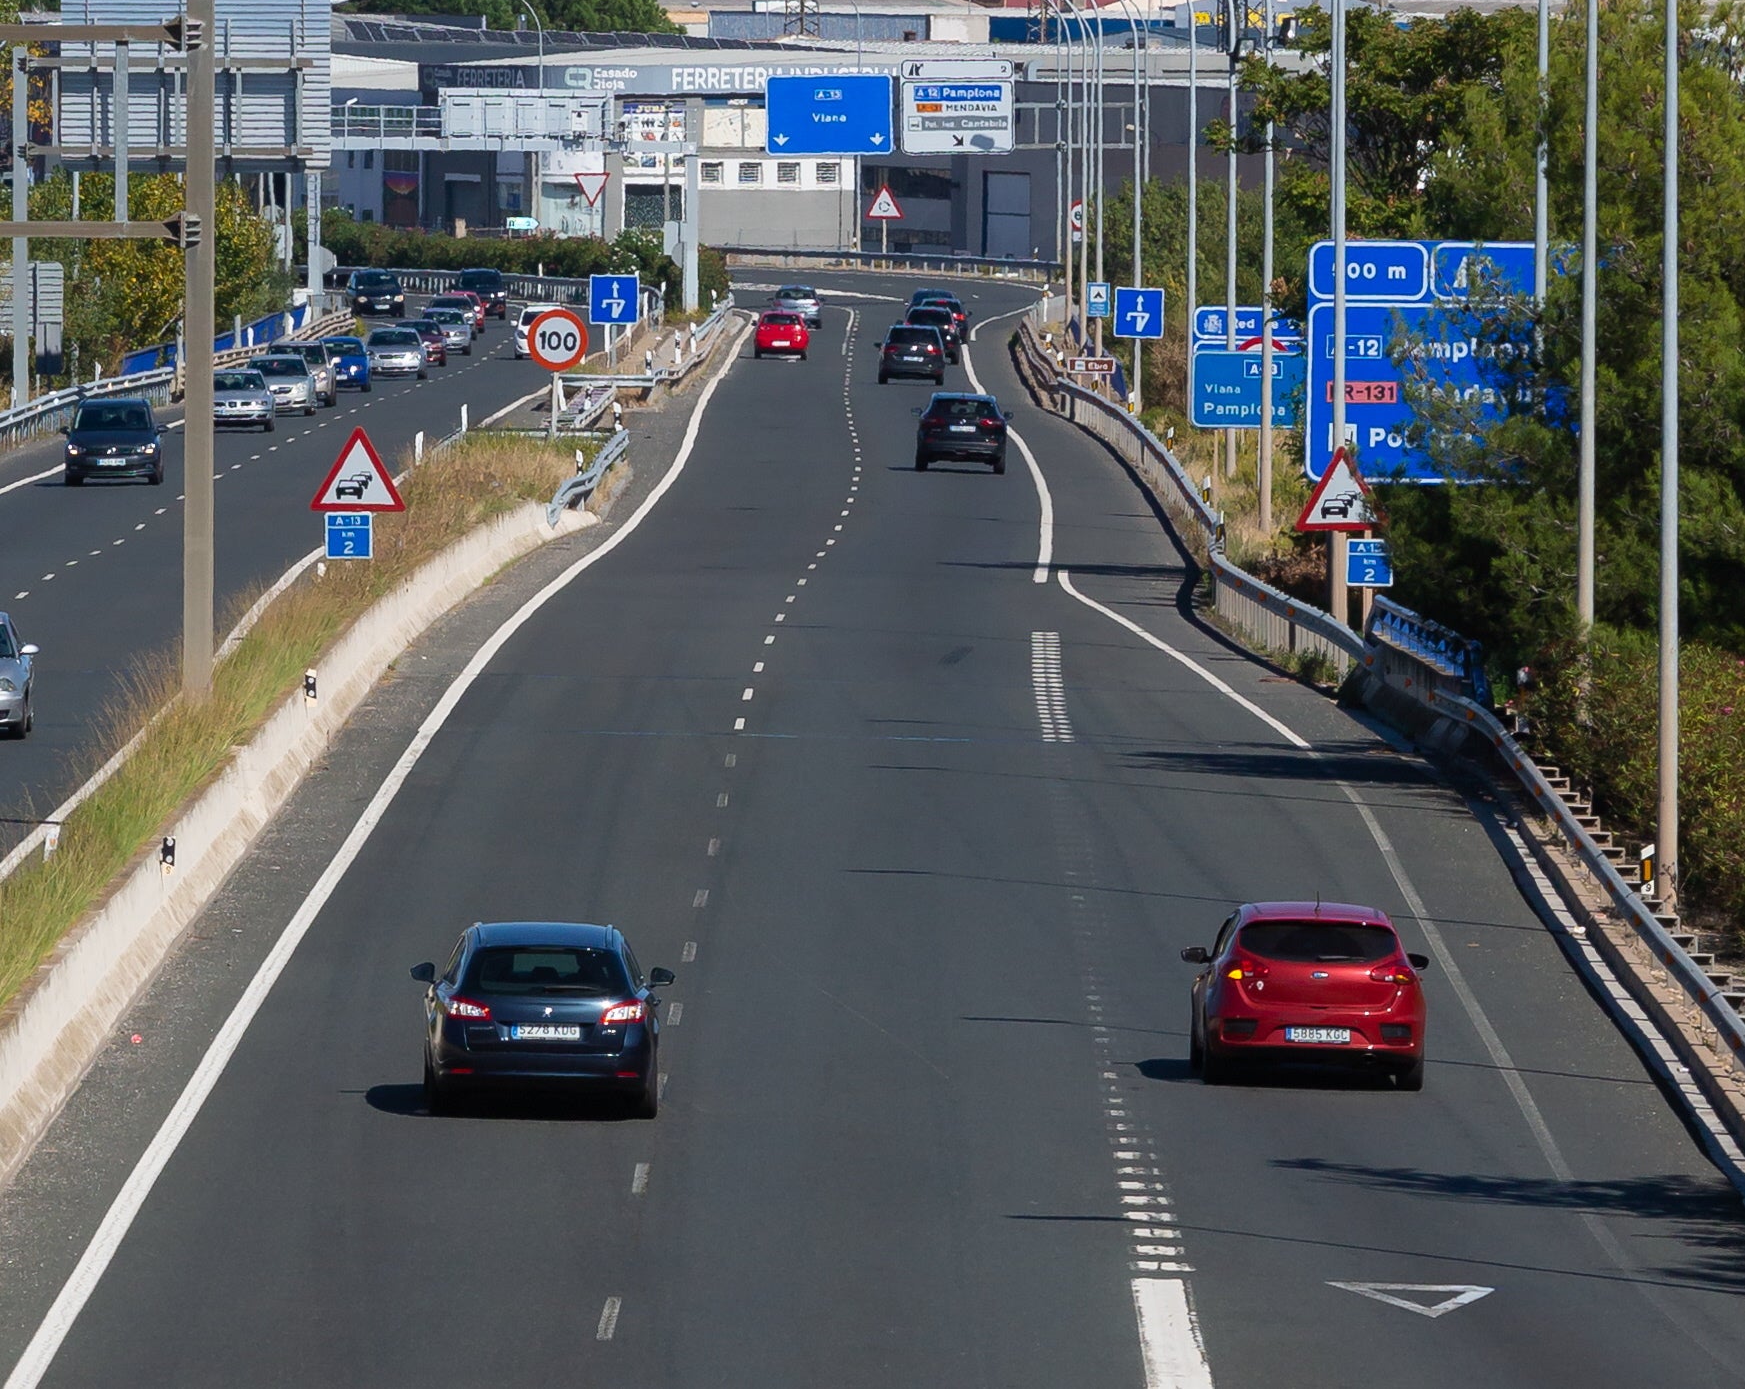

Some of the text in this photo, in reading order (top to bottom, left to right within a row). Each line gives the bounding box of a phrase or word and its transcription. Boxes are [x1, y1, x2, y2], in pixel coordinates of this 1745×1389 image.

[594, 68, 638, 78] Casado
[1000, 65, 1007, 73] 2
[943, 87, 1001, 99] Pamplona
[945, 103, 998, 112] MENDAVIA
[1332, 262, 1407, 280] 00 m
[539, 330, 578, 352] 100
[1330, 339, 1379, 356] -12
[1205, 383, 1241, 394] Viana
[343, 541, 354, 554] 2
[1363, 558, 1377, 566] km
[1364, 568, 1375, 581] 2
[1645, 883, 1652, 892] 9
